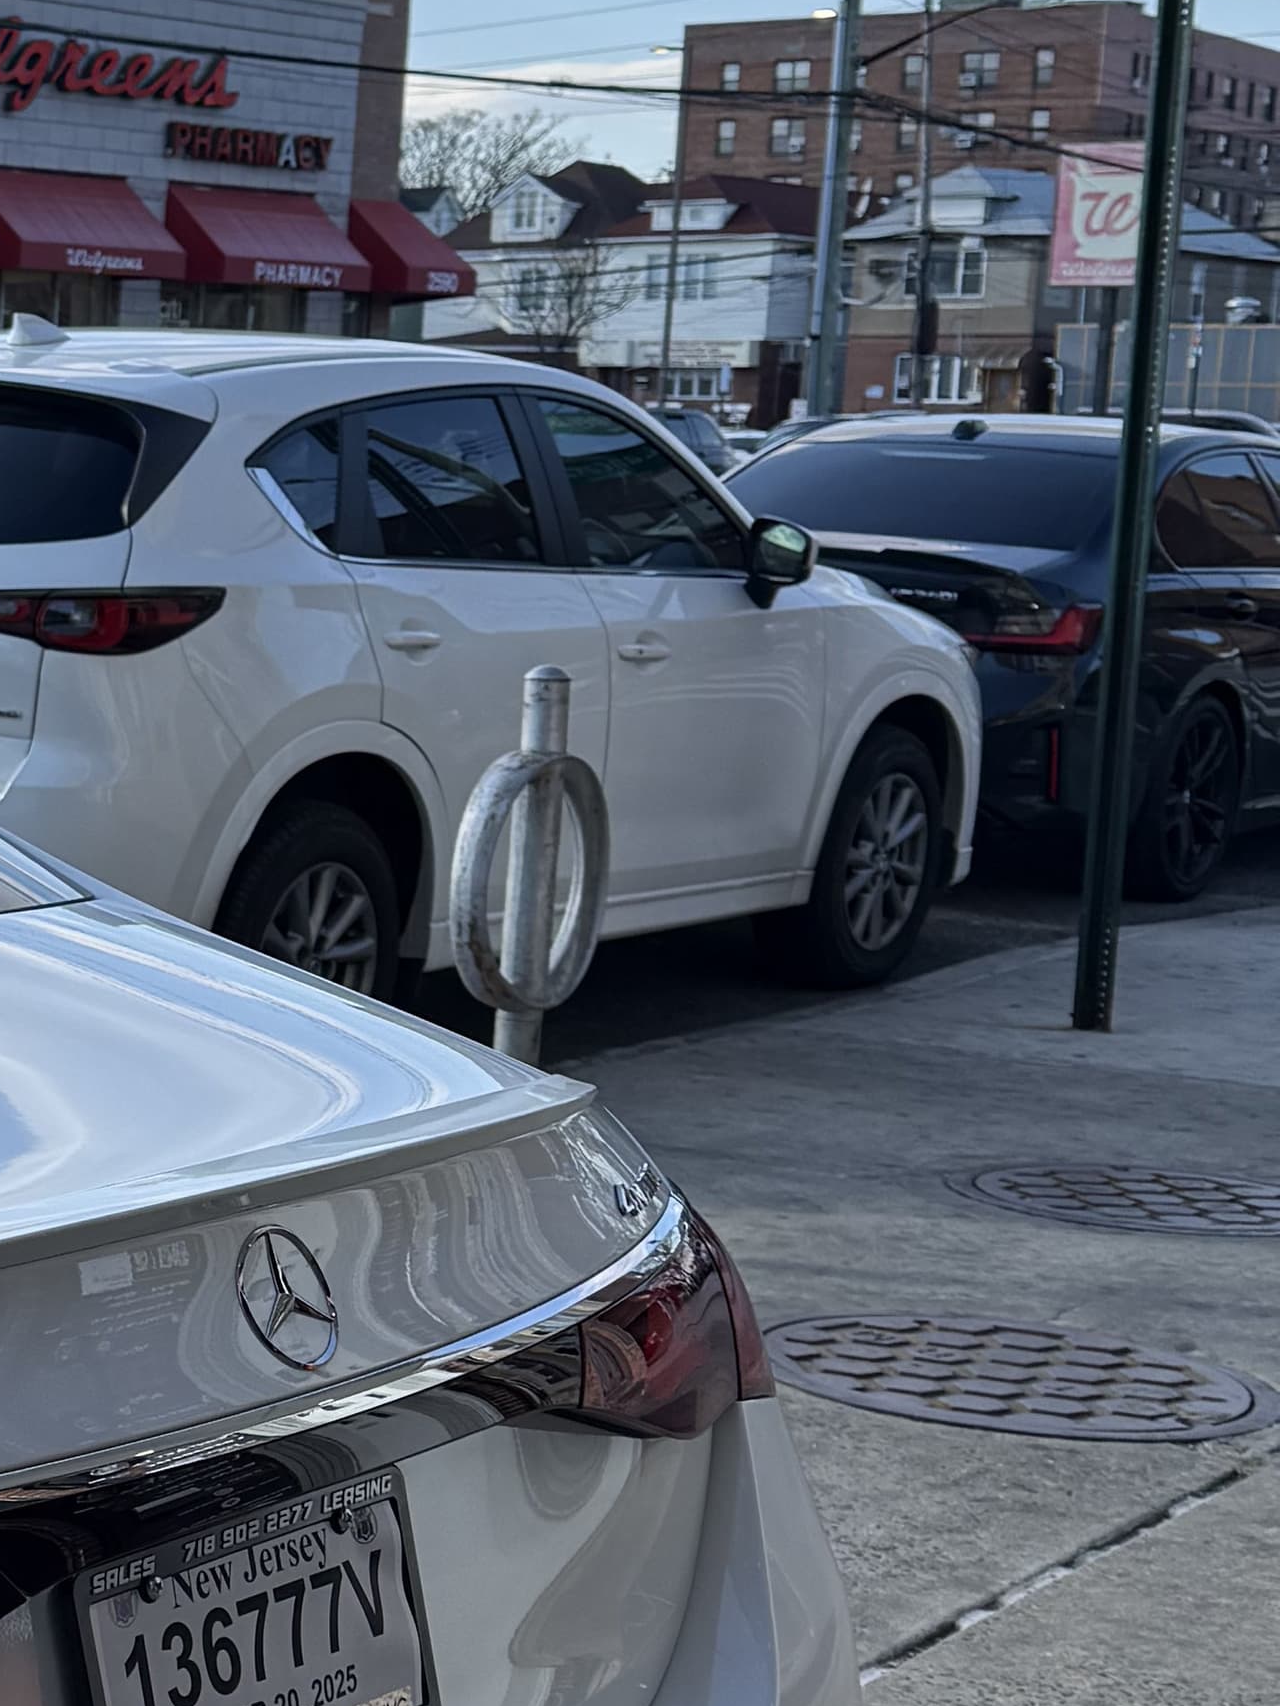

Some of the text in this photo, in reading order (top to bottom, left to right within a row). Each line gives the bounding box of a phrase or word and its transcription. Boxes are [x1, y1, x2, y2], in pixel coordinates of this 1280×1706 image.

[172, 122, 333, 170] PHARMACY
[254, 261, 343, 287] PHARMACY
[90, 1475, 393, 1595] SALES 718 902 2277 LEASING
[172, 1526, 328, 1609] New Jersey
[311, 1664, 358, 1705] 2025
